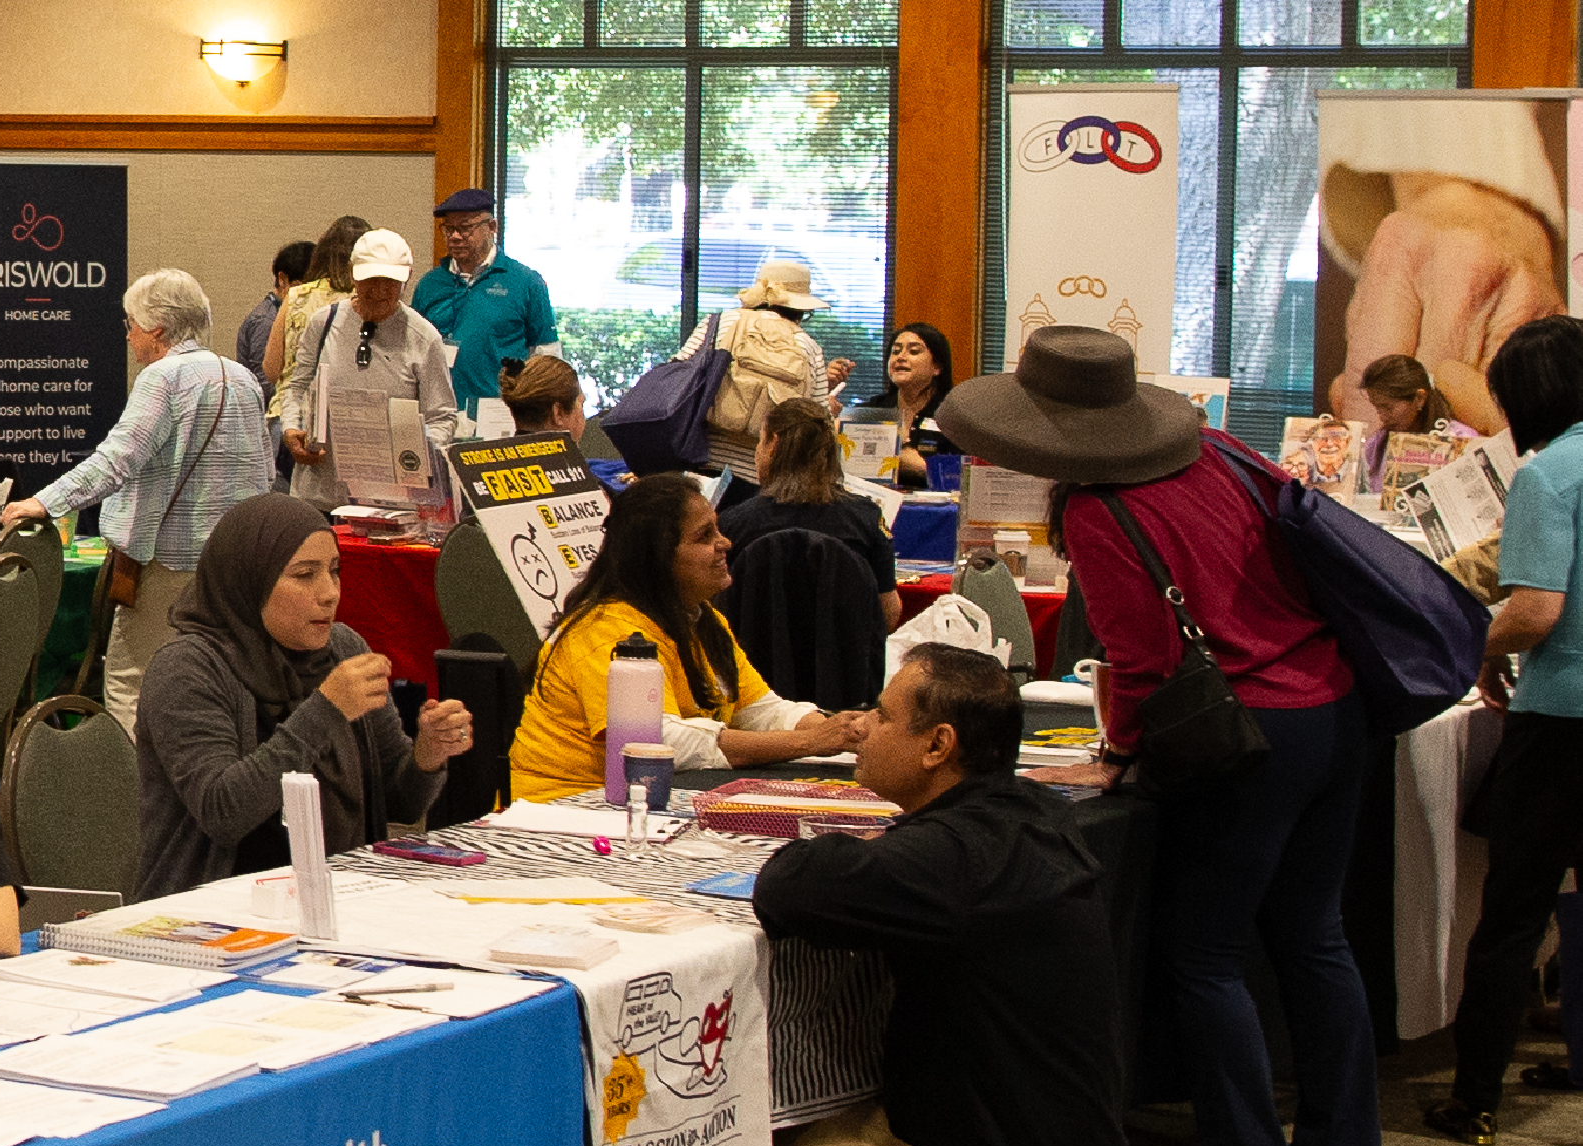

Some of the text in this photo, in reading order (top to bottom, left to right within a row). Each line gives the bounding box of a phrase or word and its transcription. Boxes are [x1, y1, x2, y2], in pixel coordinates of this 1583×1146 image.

[1045, 131, 1137, 157] F L T
[5, 311, 71, 320] HOME CARE
[43, 382, 71, 392] care
[75, 380, 93, 392] for
[25, 404, 55, 416] who
[58, 404, 91, 416] want
[47, 428, 60, 438] to
[63, 425, 86, 438] live
[29, 450, 59, 465] they
[483, 466, 551, 498] FAST
[545, 469, 571, 484] CALL
[538, 500, 603, 528] BALANCE
[559, 544, 599, 568] EYES
[701, 1104, 736, 1146] ATION
